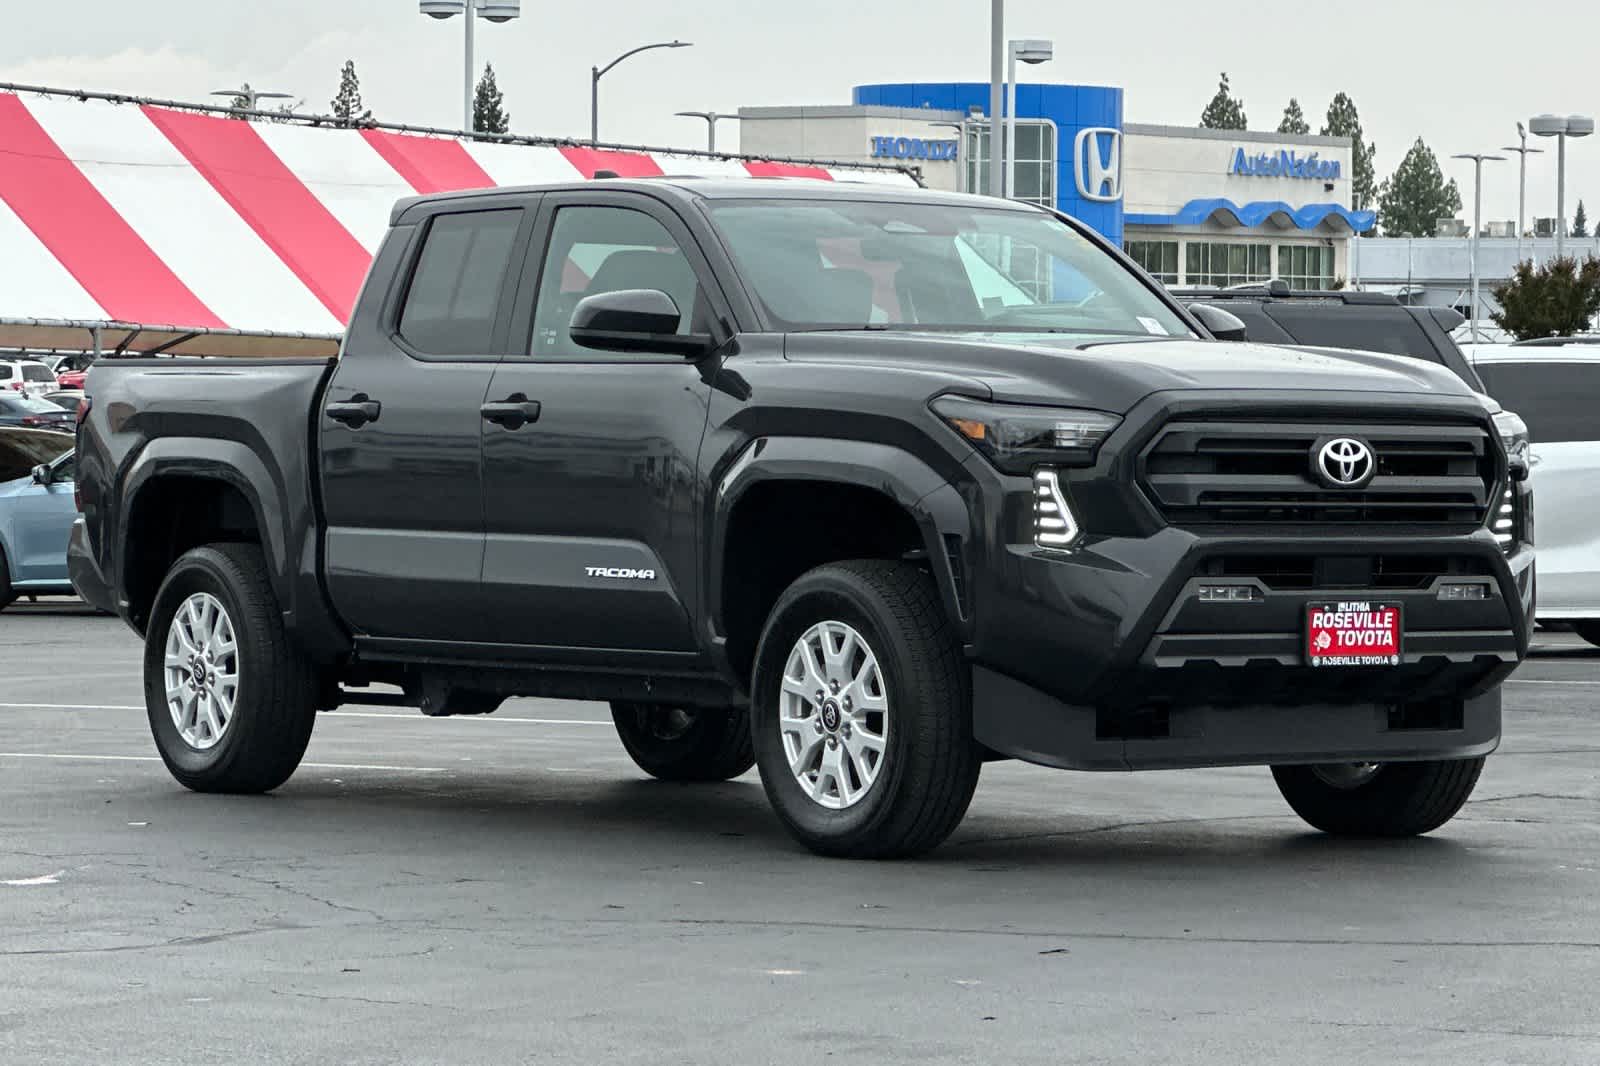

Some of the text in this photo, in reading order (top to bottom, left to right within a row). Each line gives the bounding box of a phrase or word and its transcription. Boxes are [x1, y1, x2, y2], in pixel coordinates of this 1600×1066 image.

[1232, 147, 1340, 179] AutoNation
[585, 567, 655, 579] TACOMA
[1312, 612, 1393, 628] ROSEVILLE
[1336, 630, 1393, 646] TOYOTA
